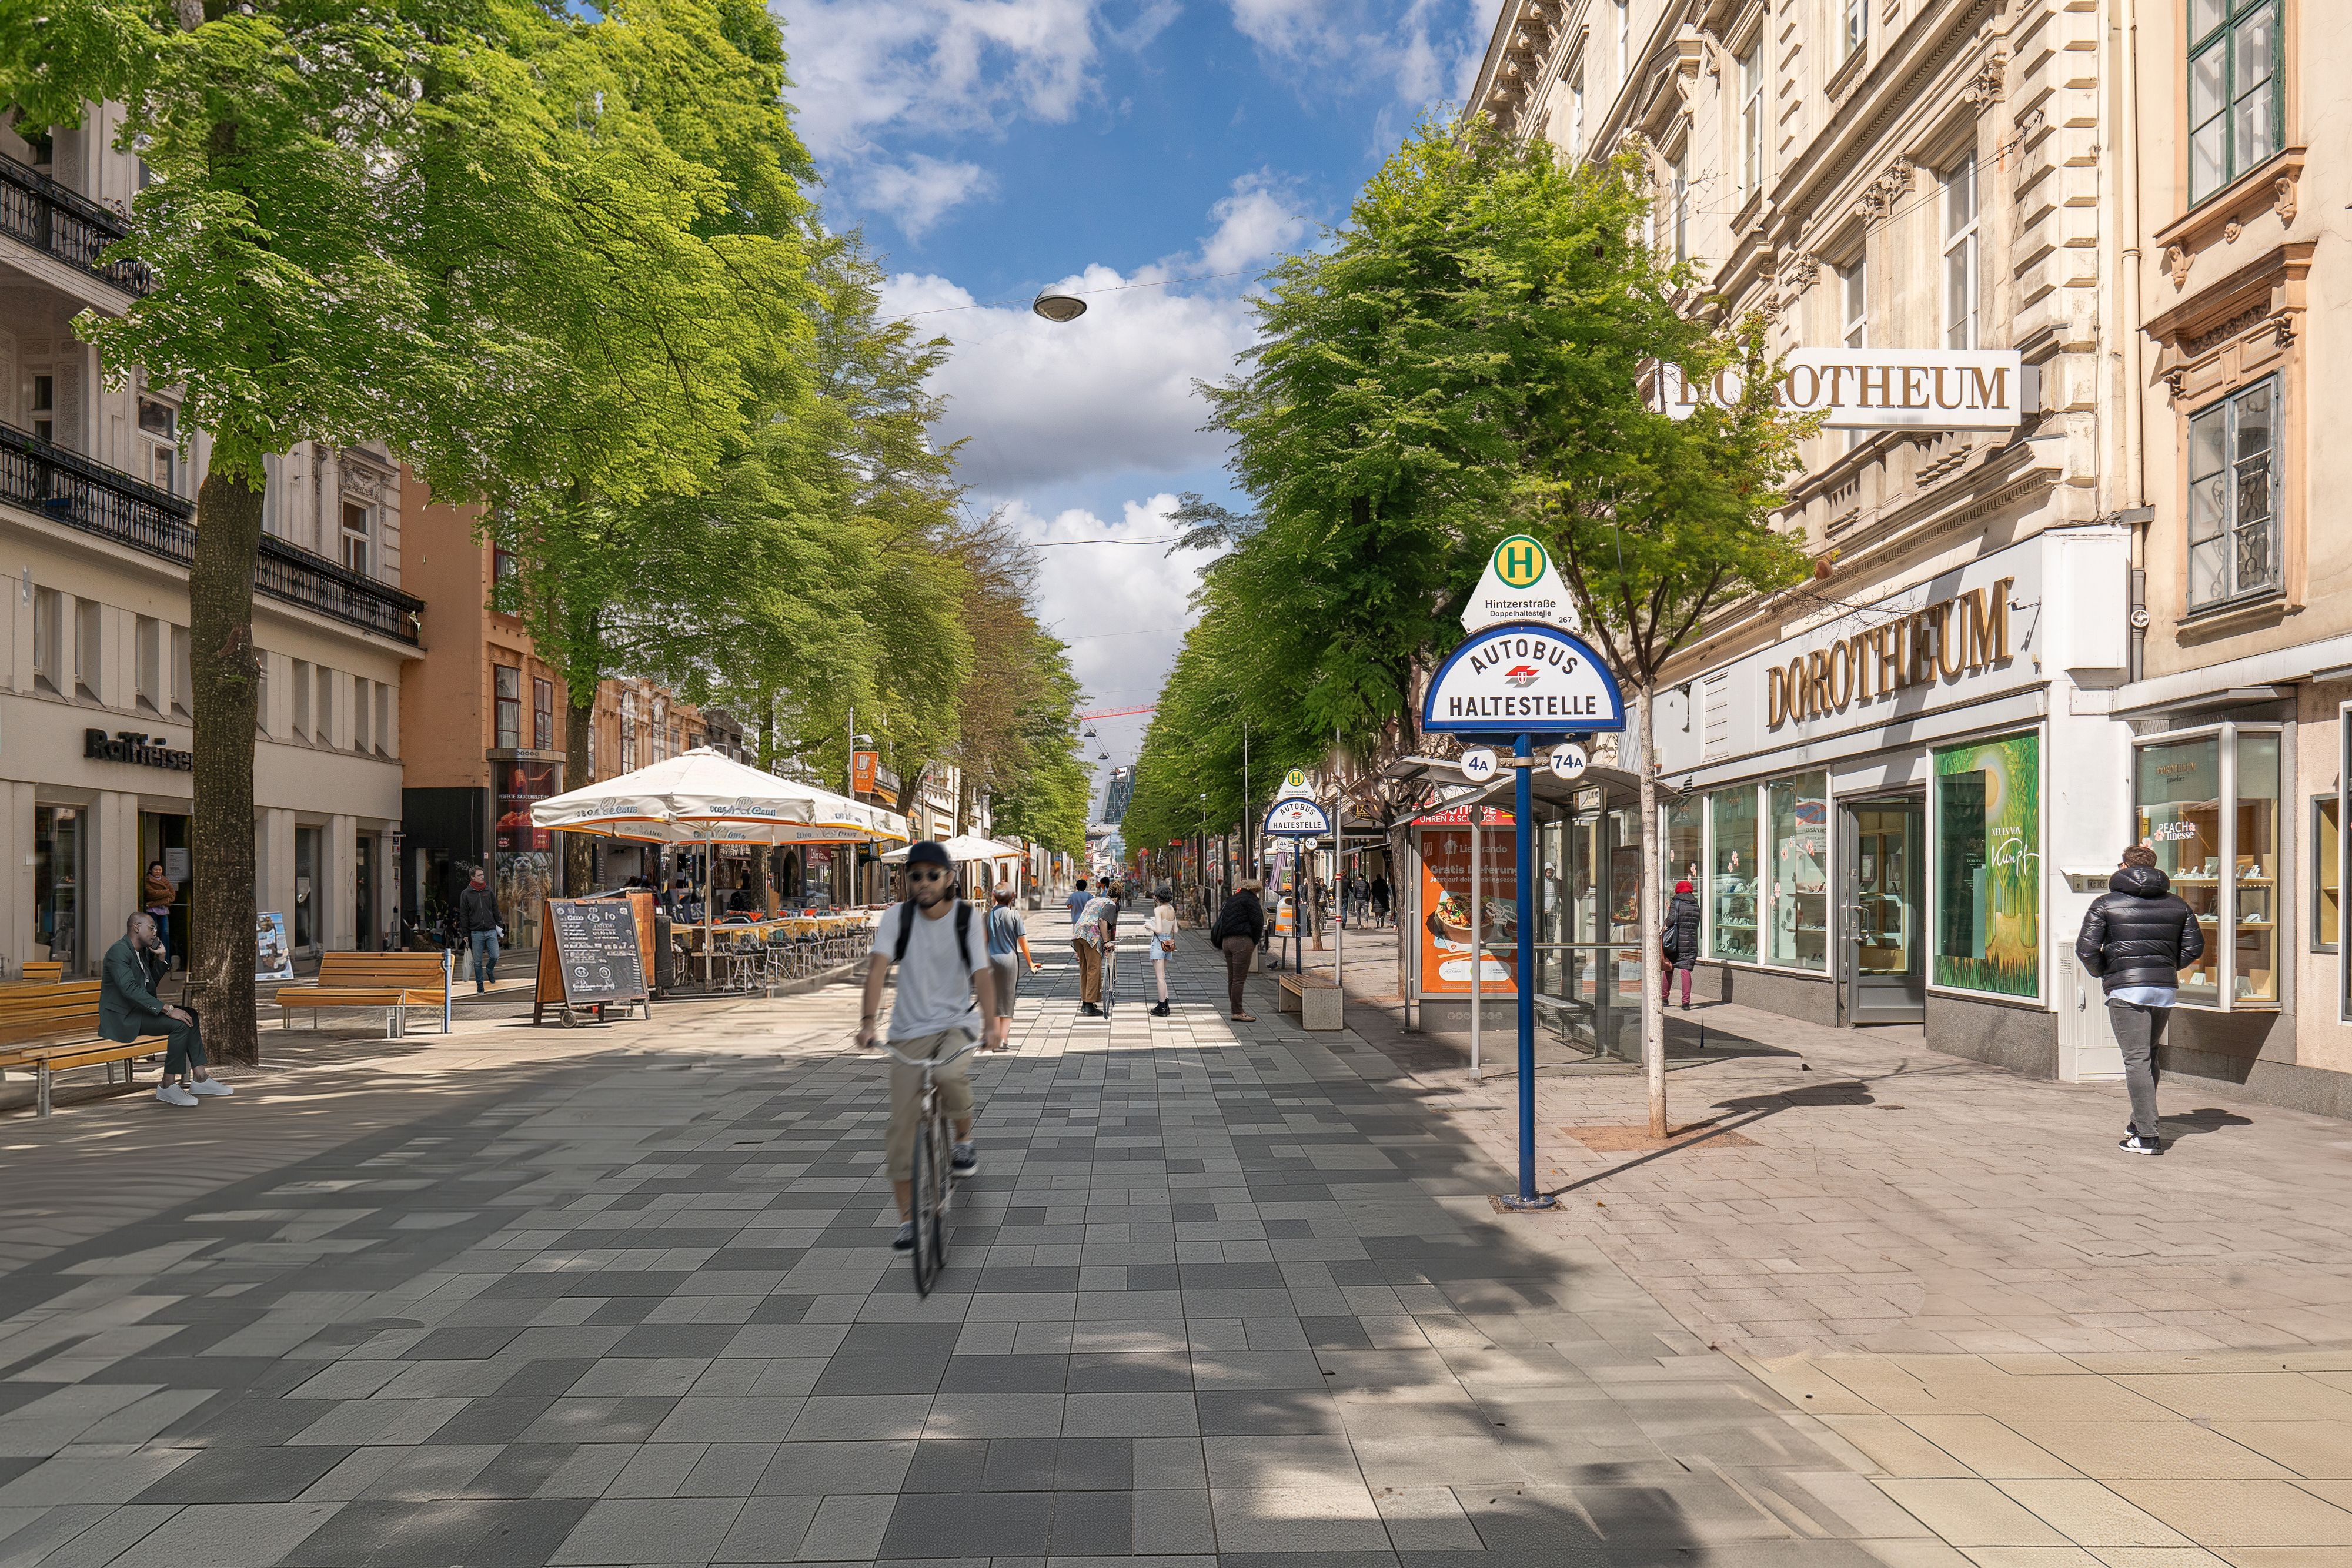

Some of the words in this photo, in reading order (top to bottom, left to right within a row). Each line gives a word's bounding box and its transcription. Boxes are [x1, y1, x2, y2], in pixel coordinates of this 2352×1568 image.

[1507, 547, 1533, 578] H
[1485, 599, 1556, 609] Hintzerstraße
[1469, 638, 1578, 676] AUTOBUS
[1766, 576, 2014, 728] DOROTHEUM
[1449, 696, 1596, 717] HALTESTELLE
[1468, 756, 1489, 771] 4A
[1553, 754, 1583, 770] 74A
[2156, 762, 2197, 775] DOROTHEUM
[1292, 773, 1301, 784] H
[2167, 775, 2185, 785] juwelier
[1279, 803, 1315, 815] AUTOBUS
[1992, 827, 2009, 836] NEUES
[2010, 826, 2021, 835] VON
[2159, 821, 2189, 834] PEACH
[1429, 864, 1465, 874] Gratis
